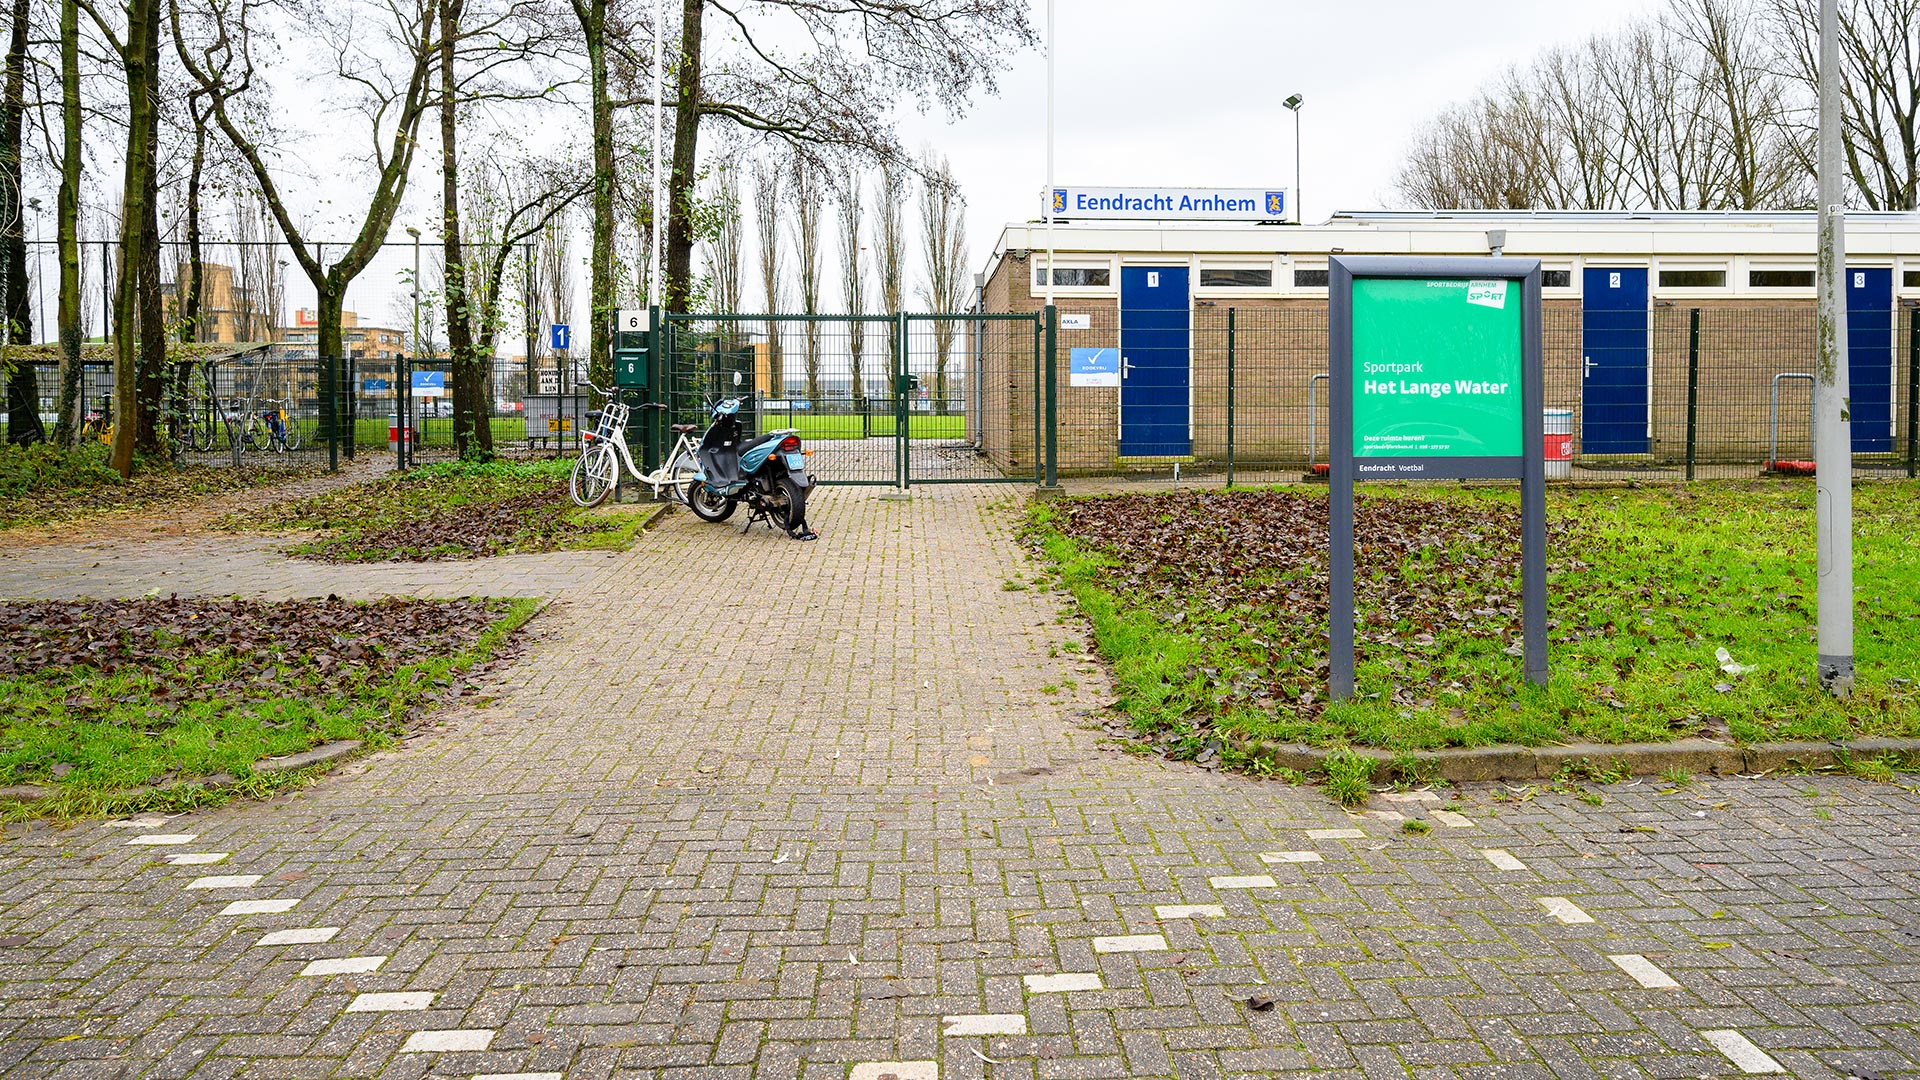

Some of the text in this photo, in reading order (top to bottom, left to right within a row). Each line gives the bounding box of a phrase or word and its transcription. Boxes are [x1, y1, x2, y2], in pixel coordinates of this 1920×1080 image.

[1077, 193, 1256, 211] Eendracht Arnhem
[1426, 281, 1469, 289] SPORTBEDRIJF
[1611, 275, 1619, 285] 2
[1856, 275, 1864, 285] 3
[630, 317, 638, 328] 6
[557, 327, 565, 346] 1
[628, 363, 635, 373] 6
[1363, 361, 1423, 375] Sportpark
[1364, 380, 1508, 398] Het Lange Water
[1363, 434, 1426, 442] Deze ruimte huren?
[1359, 464, 1424, 472] Eendracht Voetbal
